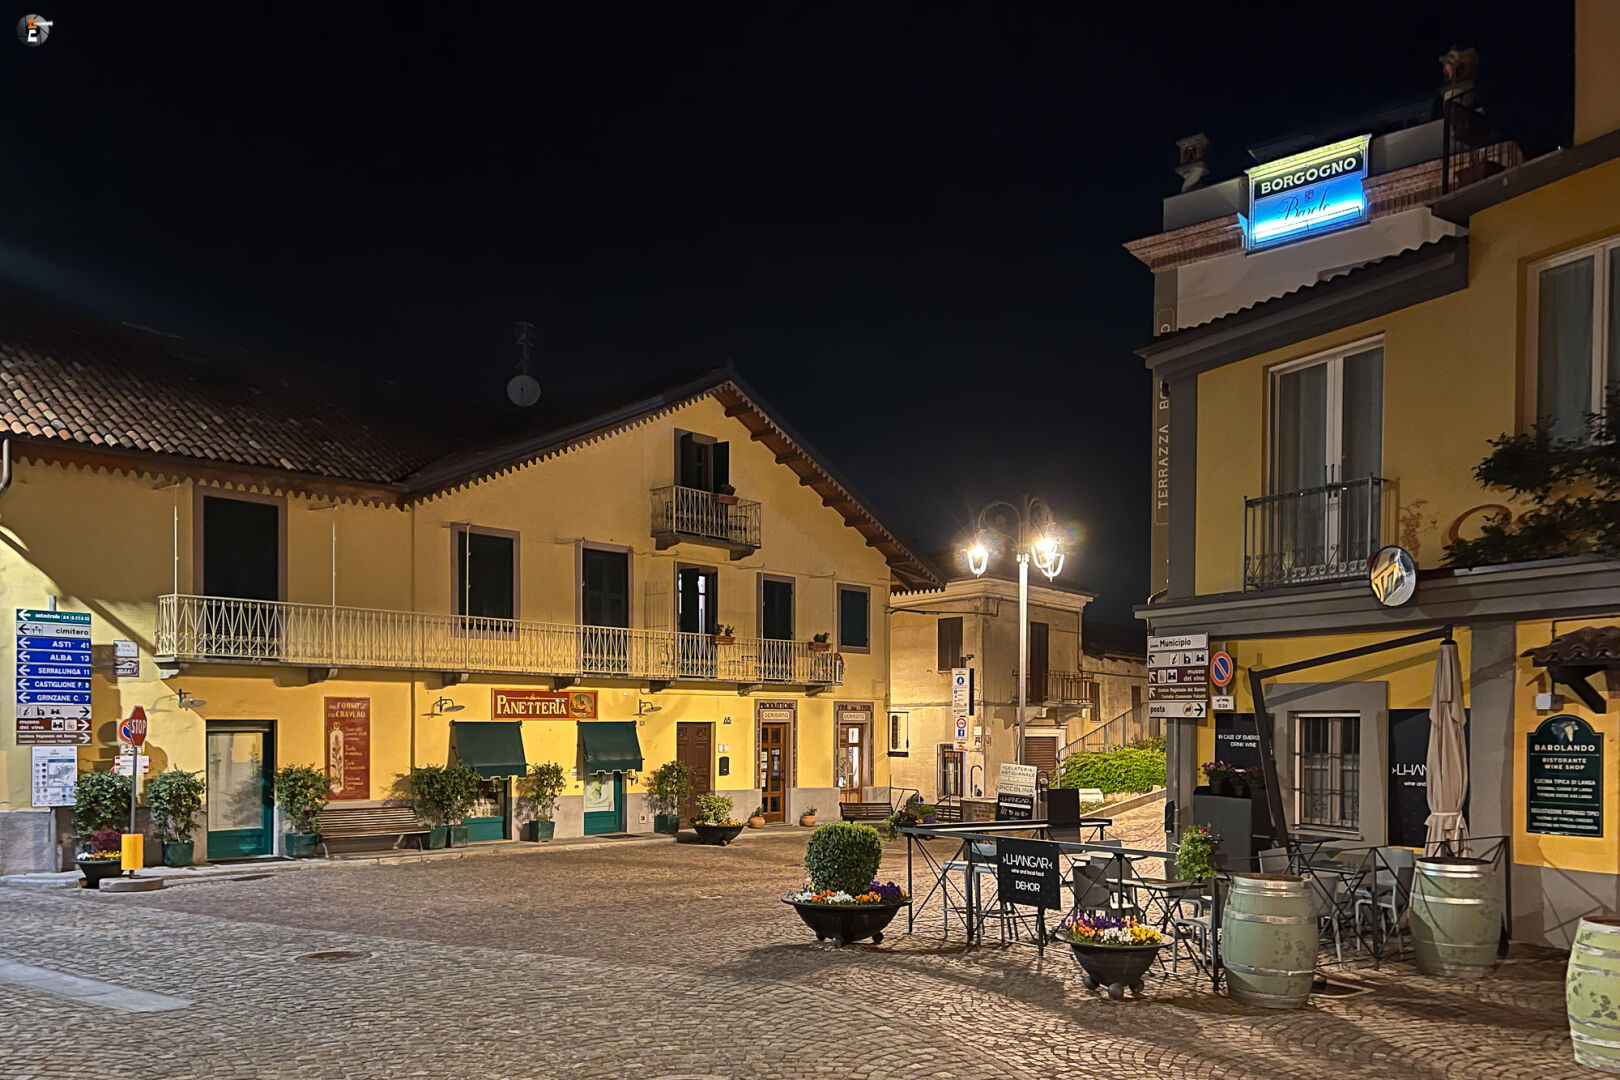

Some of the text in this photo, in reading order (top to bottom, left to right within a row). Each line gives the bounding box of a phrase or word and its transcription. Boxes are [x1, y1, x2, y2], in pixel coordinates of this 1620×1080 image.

[1260, 157, 1357, 195] BORGOGNO
[1158, 424, 1169, 509] TERRAZZA
[55, 627, 89, 636] cimitero
[52, 640, 72, 648] ASTI
[1159, 639, 1192, 648] Municipio
[38, 667, 81, 675] SERRALUNGA
[34, 681, 76, 689] CASTIGLIONE
[496, 694, 567, 715] PANETTERIA
[1150, 705, 1166, 714] posta
[723, 716, 732, 725] 65
[131, 719, 147, 734] STOP
[1534, 744, 1596, 752] BAROLANDO
[1004, 765, 1034, 773] GELATERIA
[1001, 770, 1036, 778] ARTIGIANALE
[1015, 880, 1040, 893] DEHOR
